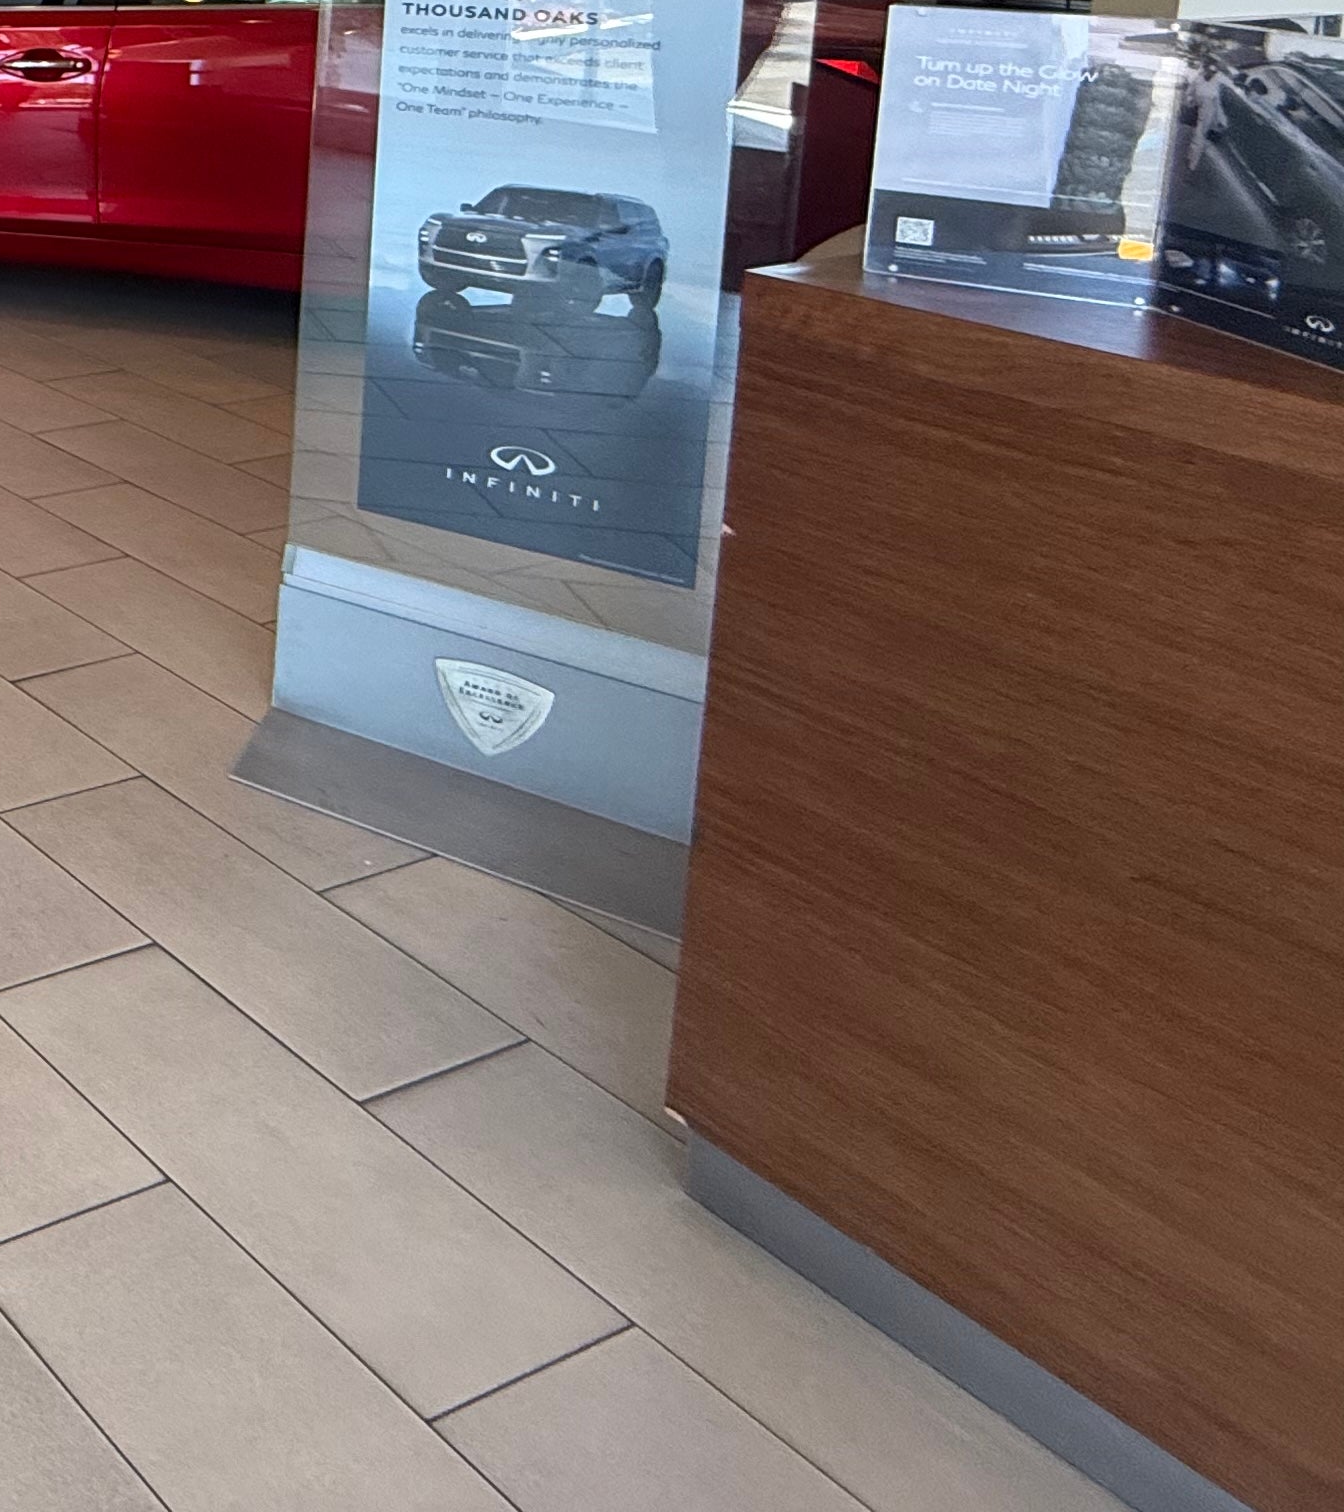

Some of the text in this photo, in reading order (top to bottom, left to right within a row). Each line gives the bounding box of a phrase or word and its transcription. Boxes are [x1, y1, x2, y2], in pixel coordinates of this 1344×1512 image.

[402, 2, 599, 25] THOUSAND OAKS
[400, 26, 439, 36] excels
[442, 28, 454, 37] in
[570, 37, 661, 50] personalized
[400, 46, 461, 57] customer
[462, 50, 509, 61] service
[512, 53, 539, 63] that
[605, 58, 645, 70] client
[916, 55, 1099, 82] Turn up the Glow
[398, 66, 481, 79] expectations
[484, 71, 509, 81] and
[513, 72, 610, 88] demonstrates
[914, 74, 1062, 99] on Date Night
[396, 101, 424, 113] One
[433, 85, 486, 99] Mindset
[503, 91, 533, 103] One
[537, 93, 614, 111] Experience
[446, 467, 600, 512] INFINITI
